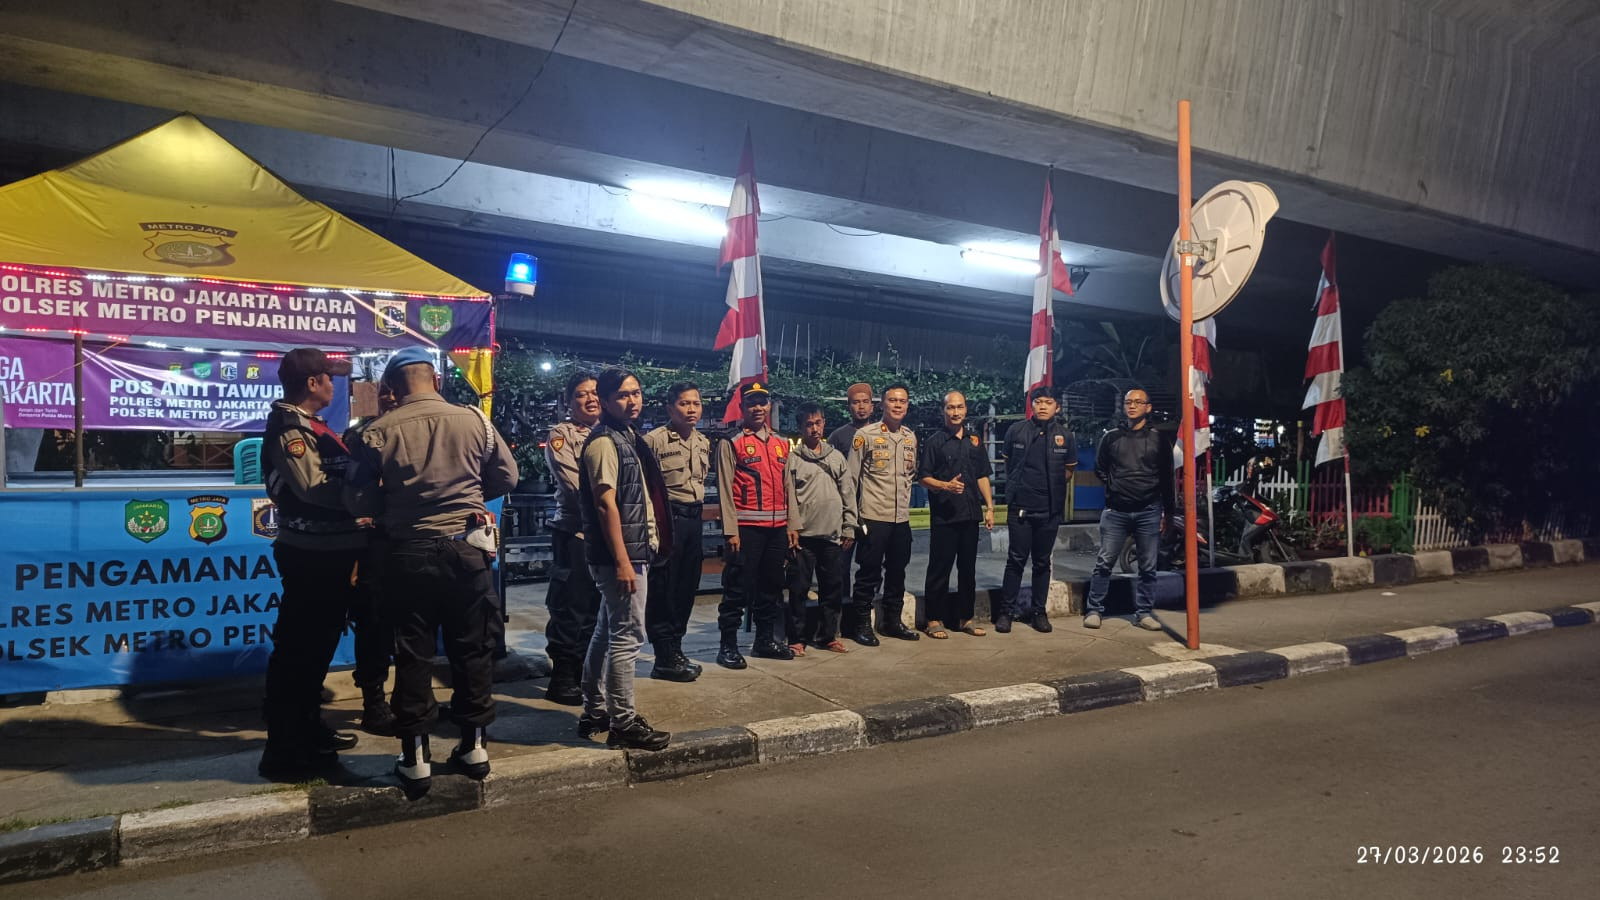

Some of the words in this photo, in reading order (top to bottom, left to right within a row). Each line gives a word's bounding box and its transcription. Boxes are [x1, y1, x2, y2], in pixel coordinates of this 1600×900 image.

[147, 223, 194, 231] METRO
[198, 226, 228, 236] JAYA
[2, 275, 83, 296] OLRES
[92, 281, 175, 302] METRO
[184, 289, 281, 310] JAKARTA
[289, 296, 356, 315] UTARA
[3, 296, 89, 318] OLSEK
[98, 302, 187, 323] METRO
[196, 309, 356, 333] PENJARINGAN
[110, 379, 153, 395] POS
[160, 383, 209, 398] ANTI
[109, 396, 162, 408] POLRES
[166, 399, 211, 409] METRO
[215, 400, 271, 410] JAKARTA
[109, 407, 164, 418] POLSEK
[169, 410, 217, 420] METRO
[86, 597, 196, 624] METRO
[0, 635, 91, 661] LSEK
[103, 627, 212, 655] METRO
